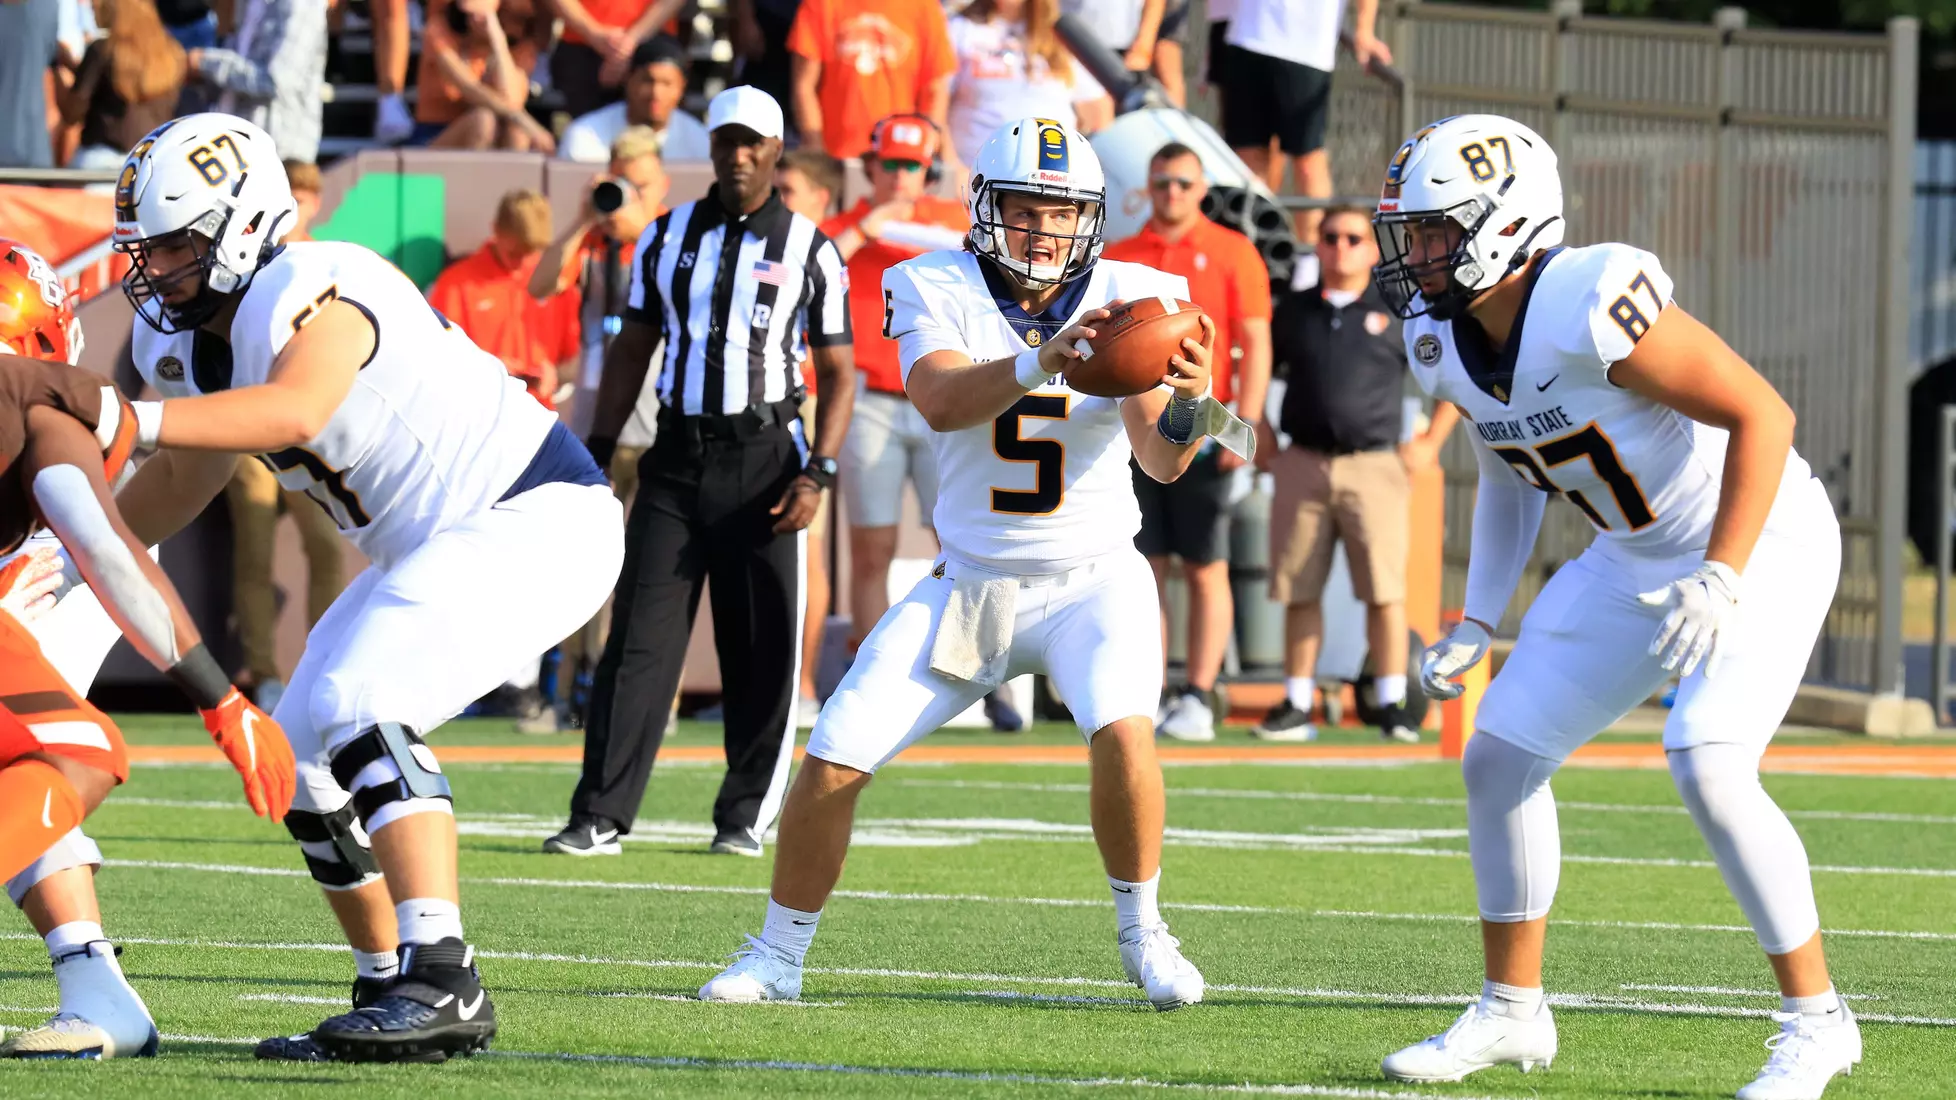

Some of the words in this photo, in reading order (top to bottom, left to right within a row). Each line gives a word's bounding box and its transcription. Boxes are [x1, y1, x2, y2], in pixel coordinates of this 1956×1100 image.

[186, 133, 248, 187] 67
[1040, 172, 1068, 182] Riddell
[1458, 136, 1516, 184] 87
[678, 251, 696, 268] S
[1608, 268, 1663, 346] 87
[1526, 405, 1573, 437] STATE
[989, 392, 1071, 517] 5
